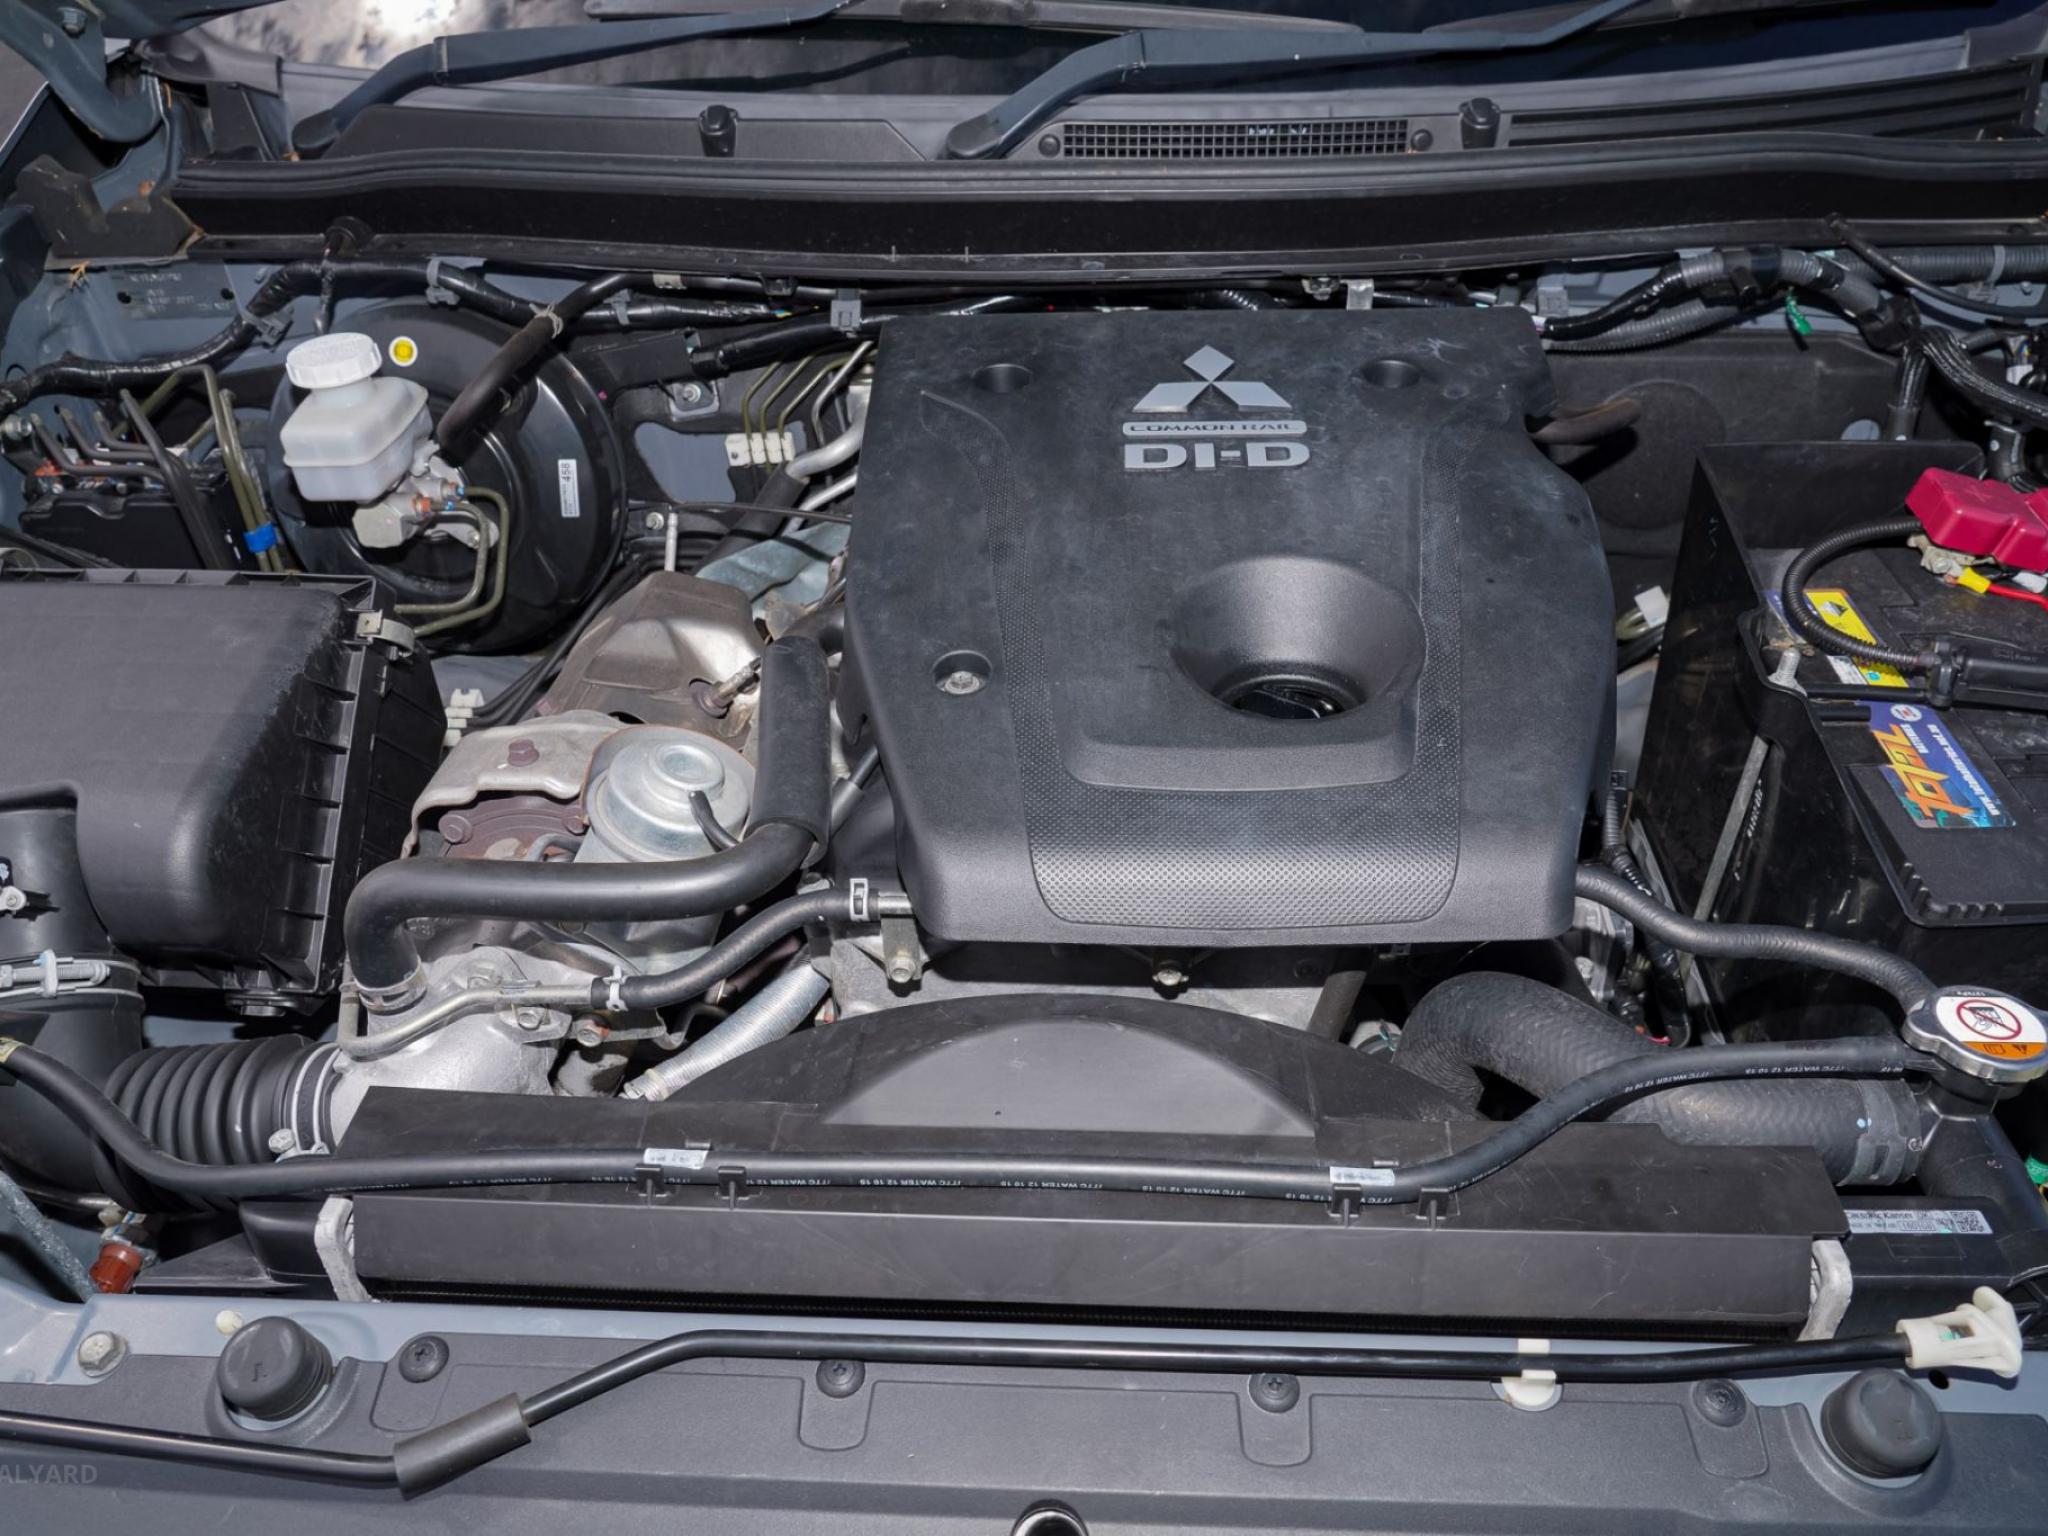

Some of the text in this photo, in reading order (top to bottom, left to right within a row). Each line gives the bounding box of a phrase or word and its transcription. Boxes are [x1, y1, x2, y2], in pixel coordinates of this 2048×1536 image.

[1130, 423, 1235, 432] COMMON
[1124, 441, 1311, 470] DI-D
[1871, 723, 1977, 818] TOTAL
